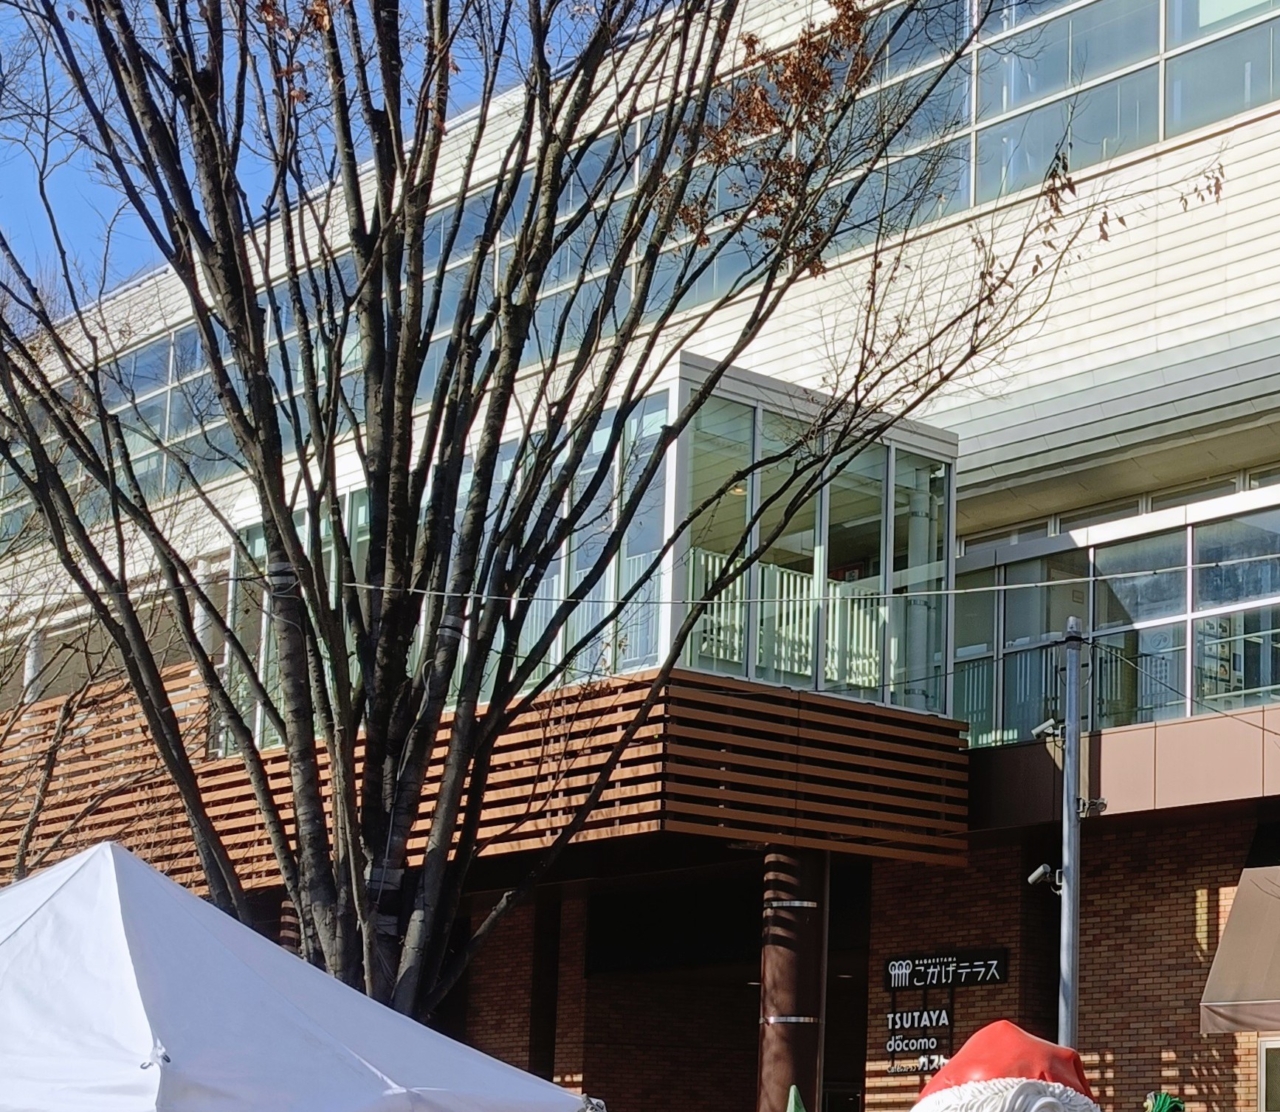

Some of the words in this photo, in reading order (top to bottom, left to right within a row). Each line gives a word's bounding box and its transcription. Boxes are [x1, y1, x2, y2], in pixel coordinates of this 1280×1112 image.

[913, 960, 1000, 986] こかげテラス
[886, 1009, 949, 1030] TSUTAYA
[886, 1036, 937, 1052] docomo
